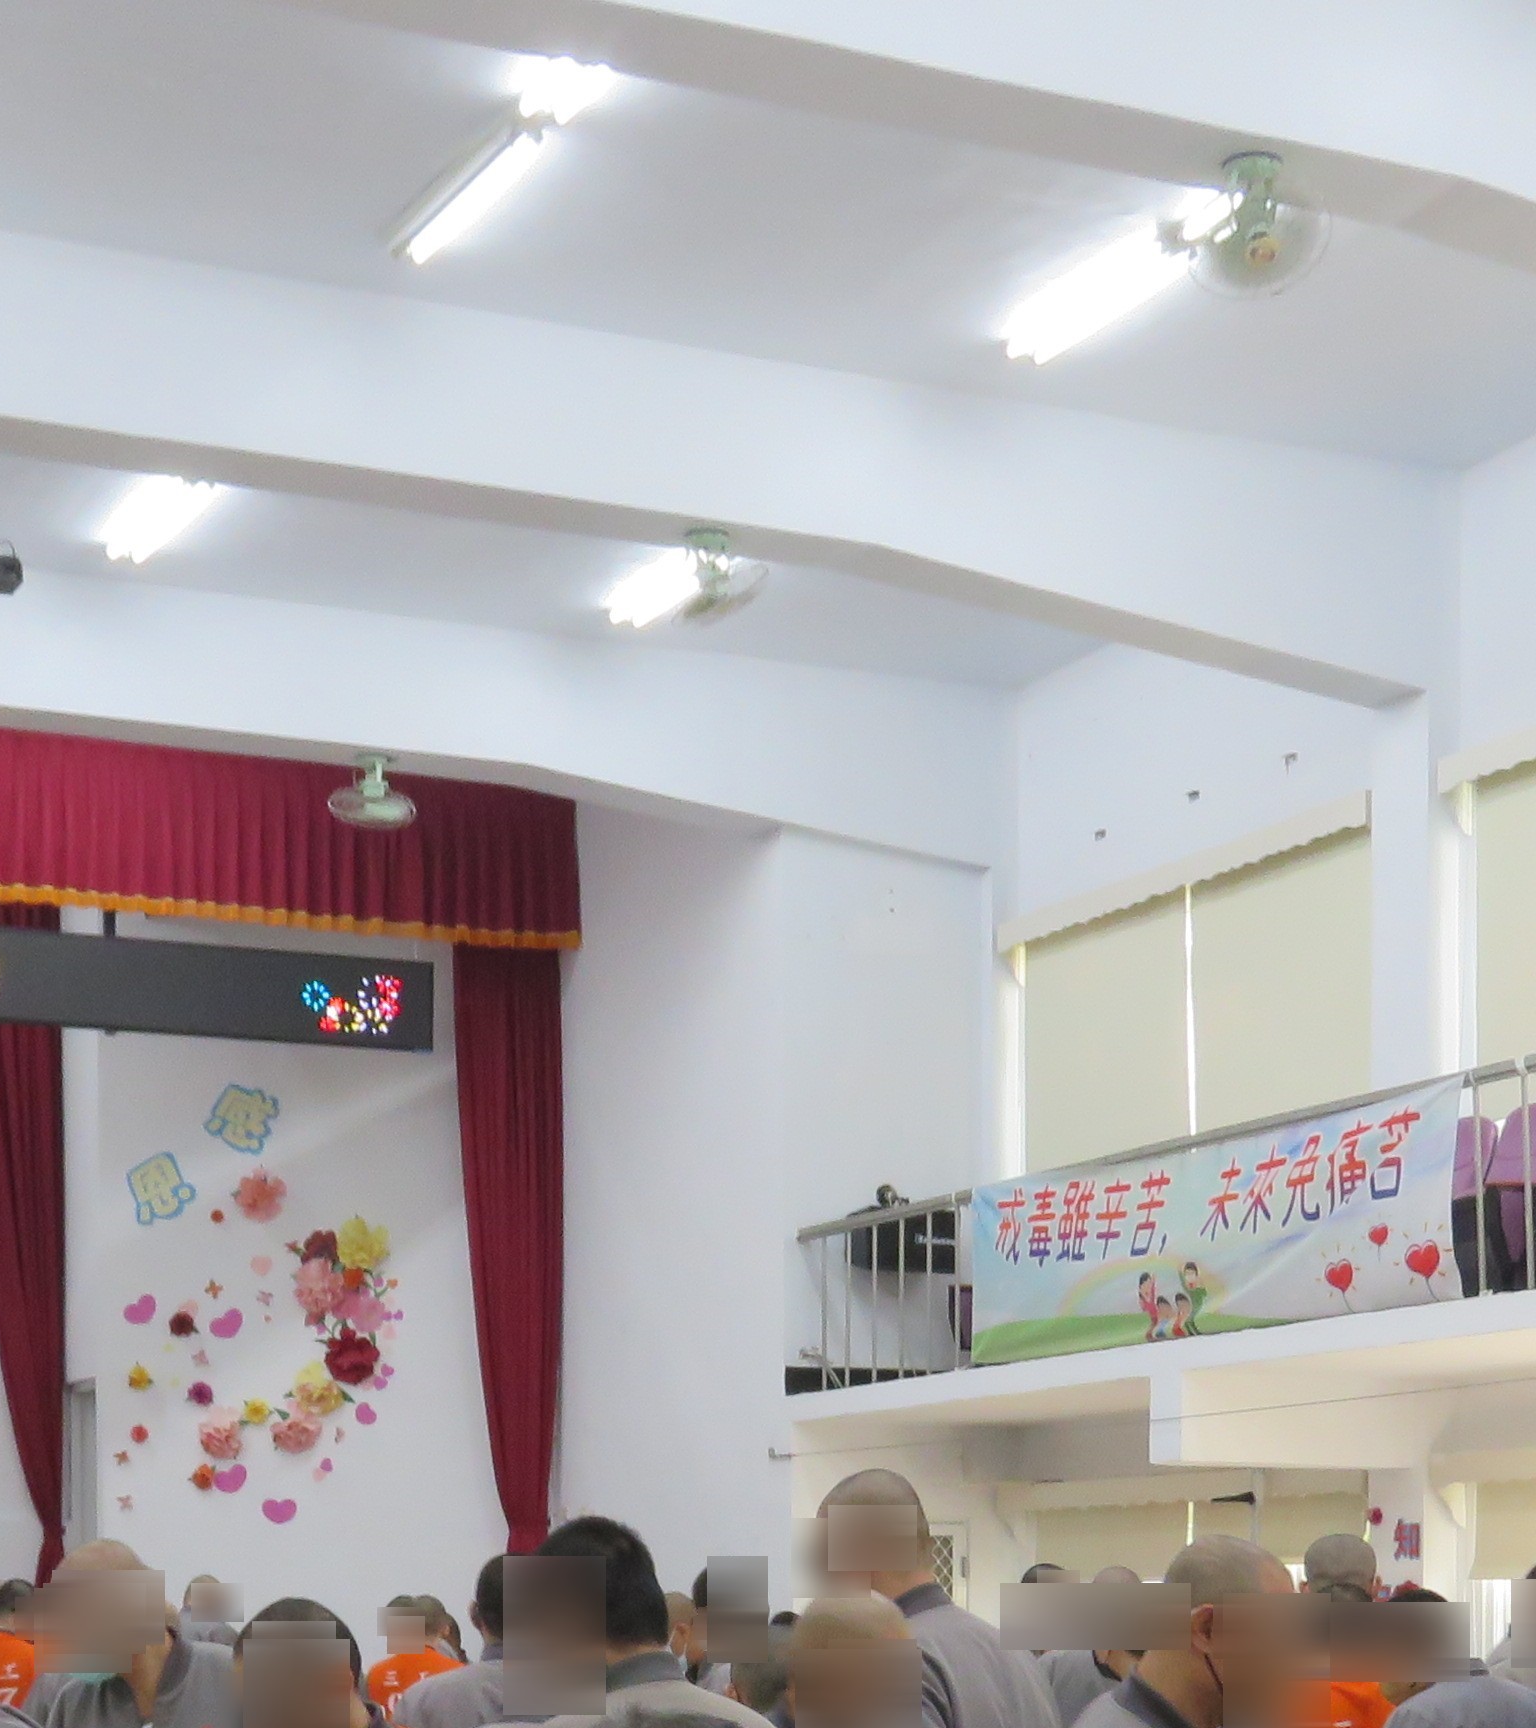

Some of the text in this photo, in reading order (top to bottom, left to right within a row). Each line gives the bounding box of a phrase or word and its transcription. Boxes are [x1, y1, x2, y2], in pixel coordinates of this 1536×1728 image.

[1199, 1107, 1422, 1243] 未來免痛苦
